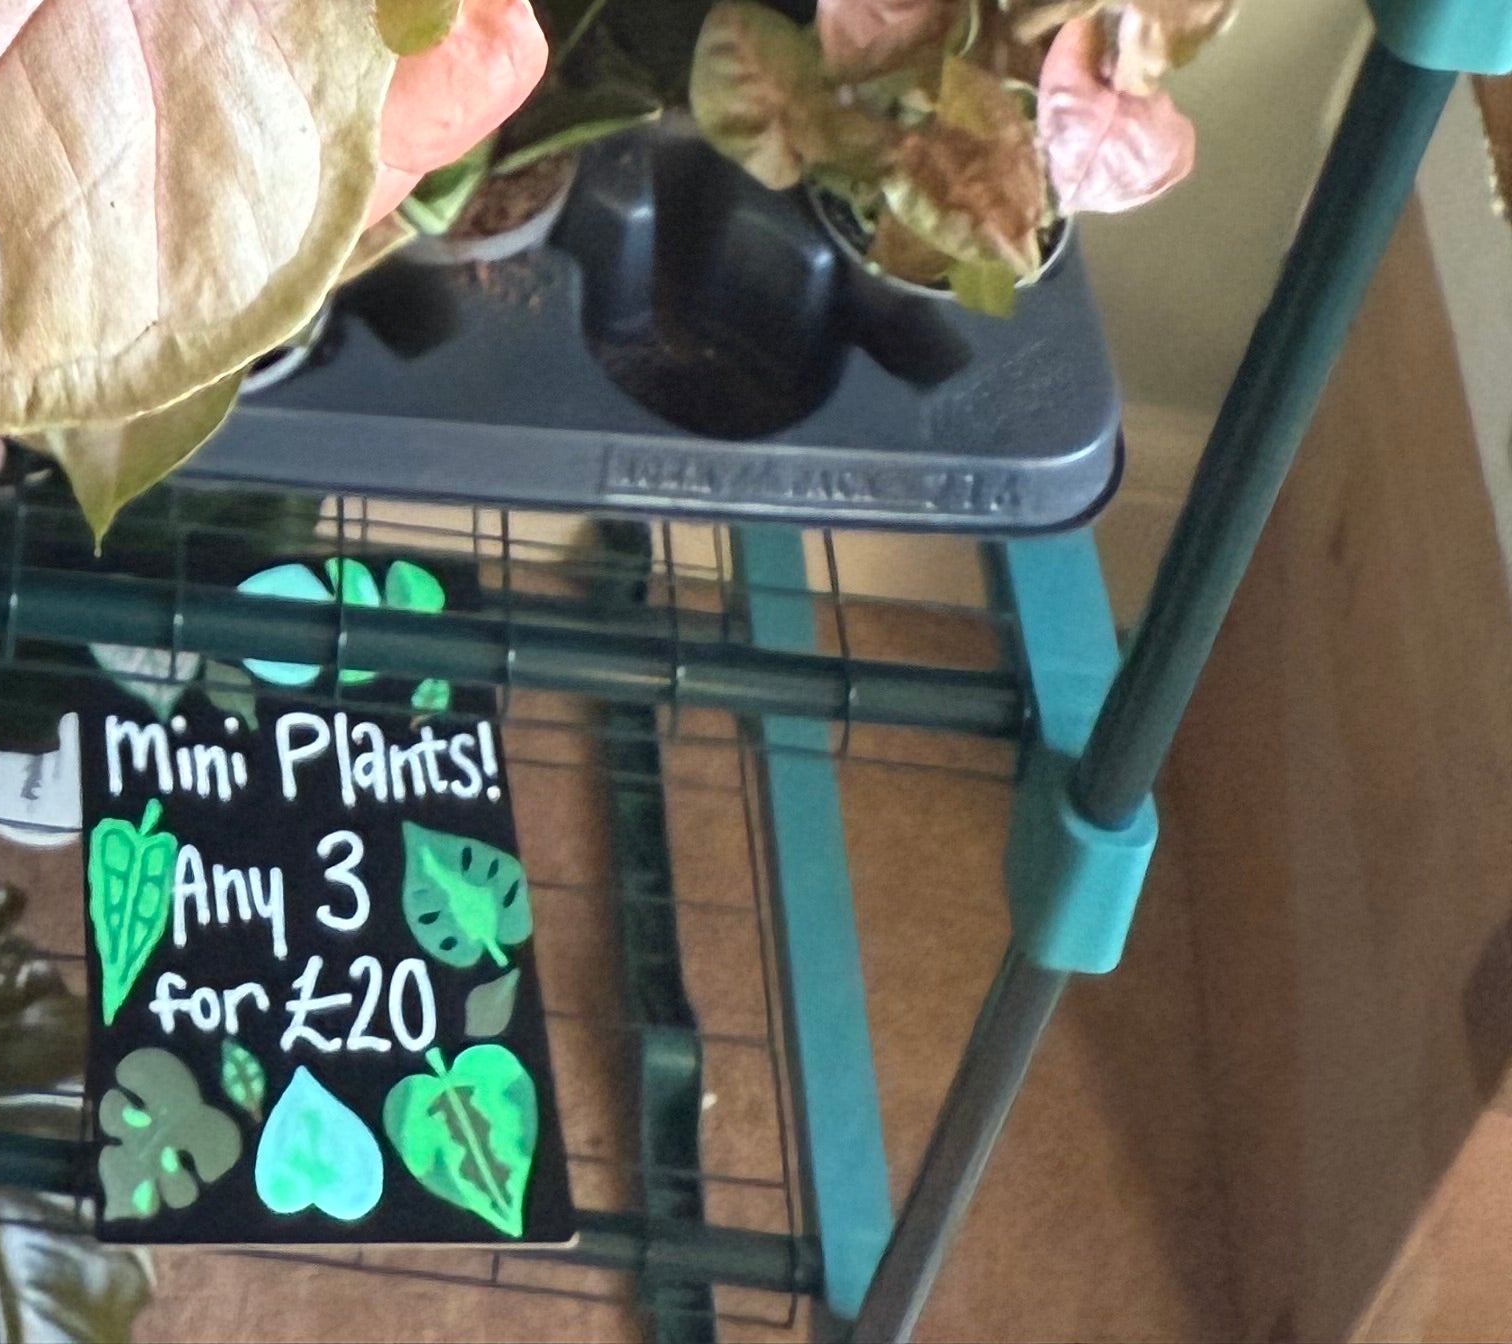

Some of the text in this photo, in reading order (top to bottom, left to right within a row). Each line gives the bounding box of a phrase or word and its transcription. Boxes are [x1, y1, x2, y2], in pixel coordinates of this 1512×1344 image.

[104, 714, 248, 803] Mini
[275, 711, 501, 807] Plants!
[172, 829, 371, 961] Any 3
[148, 955, 437, 1053] for £20
